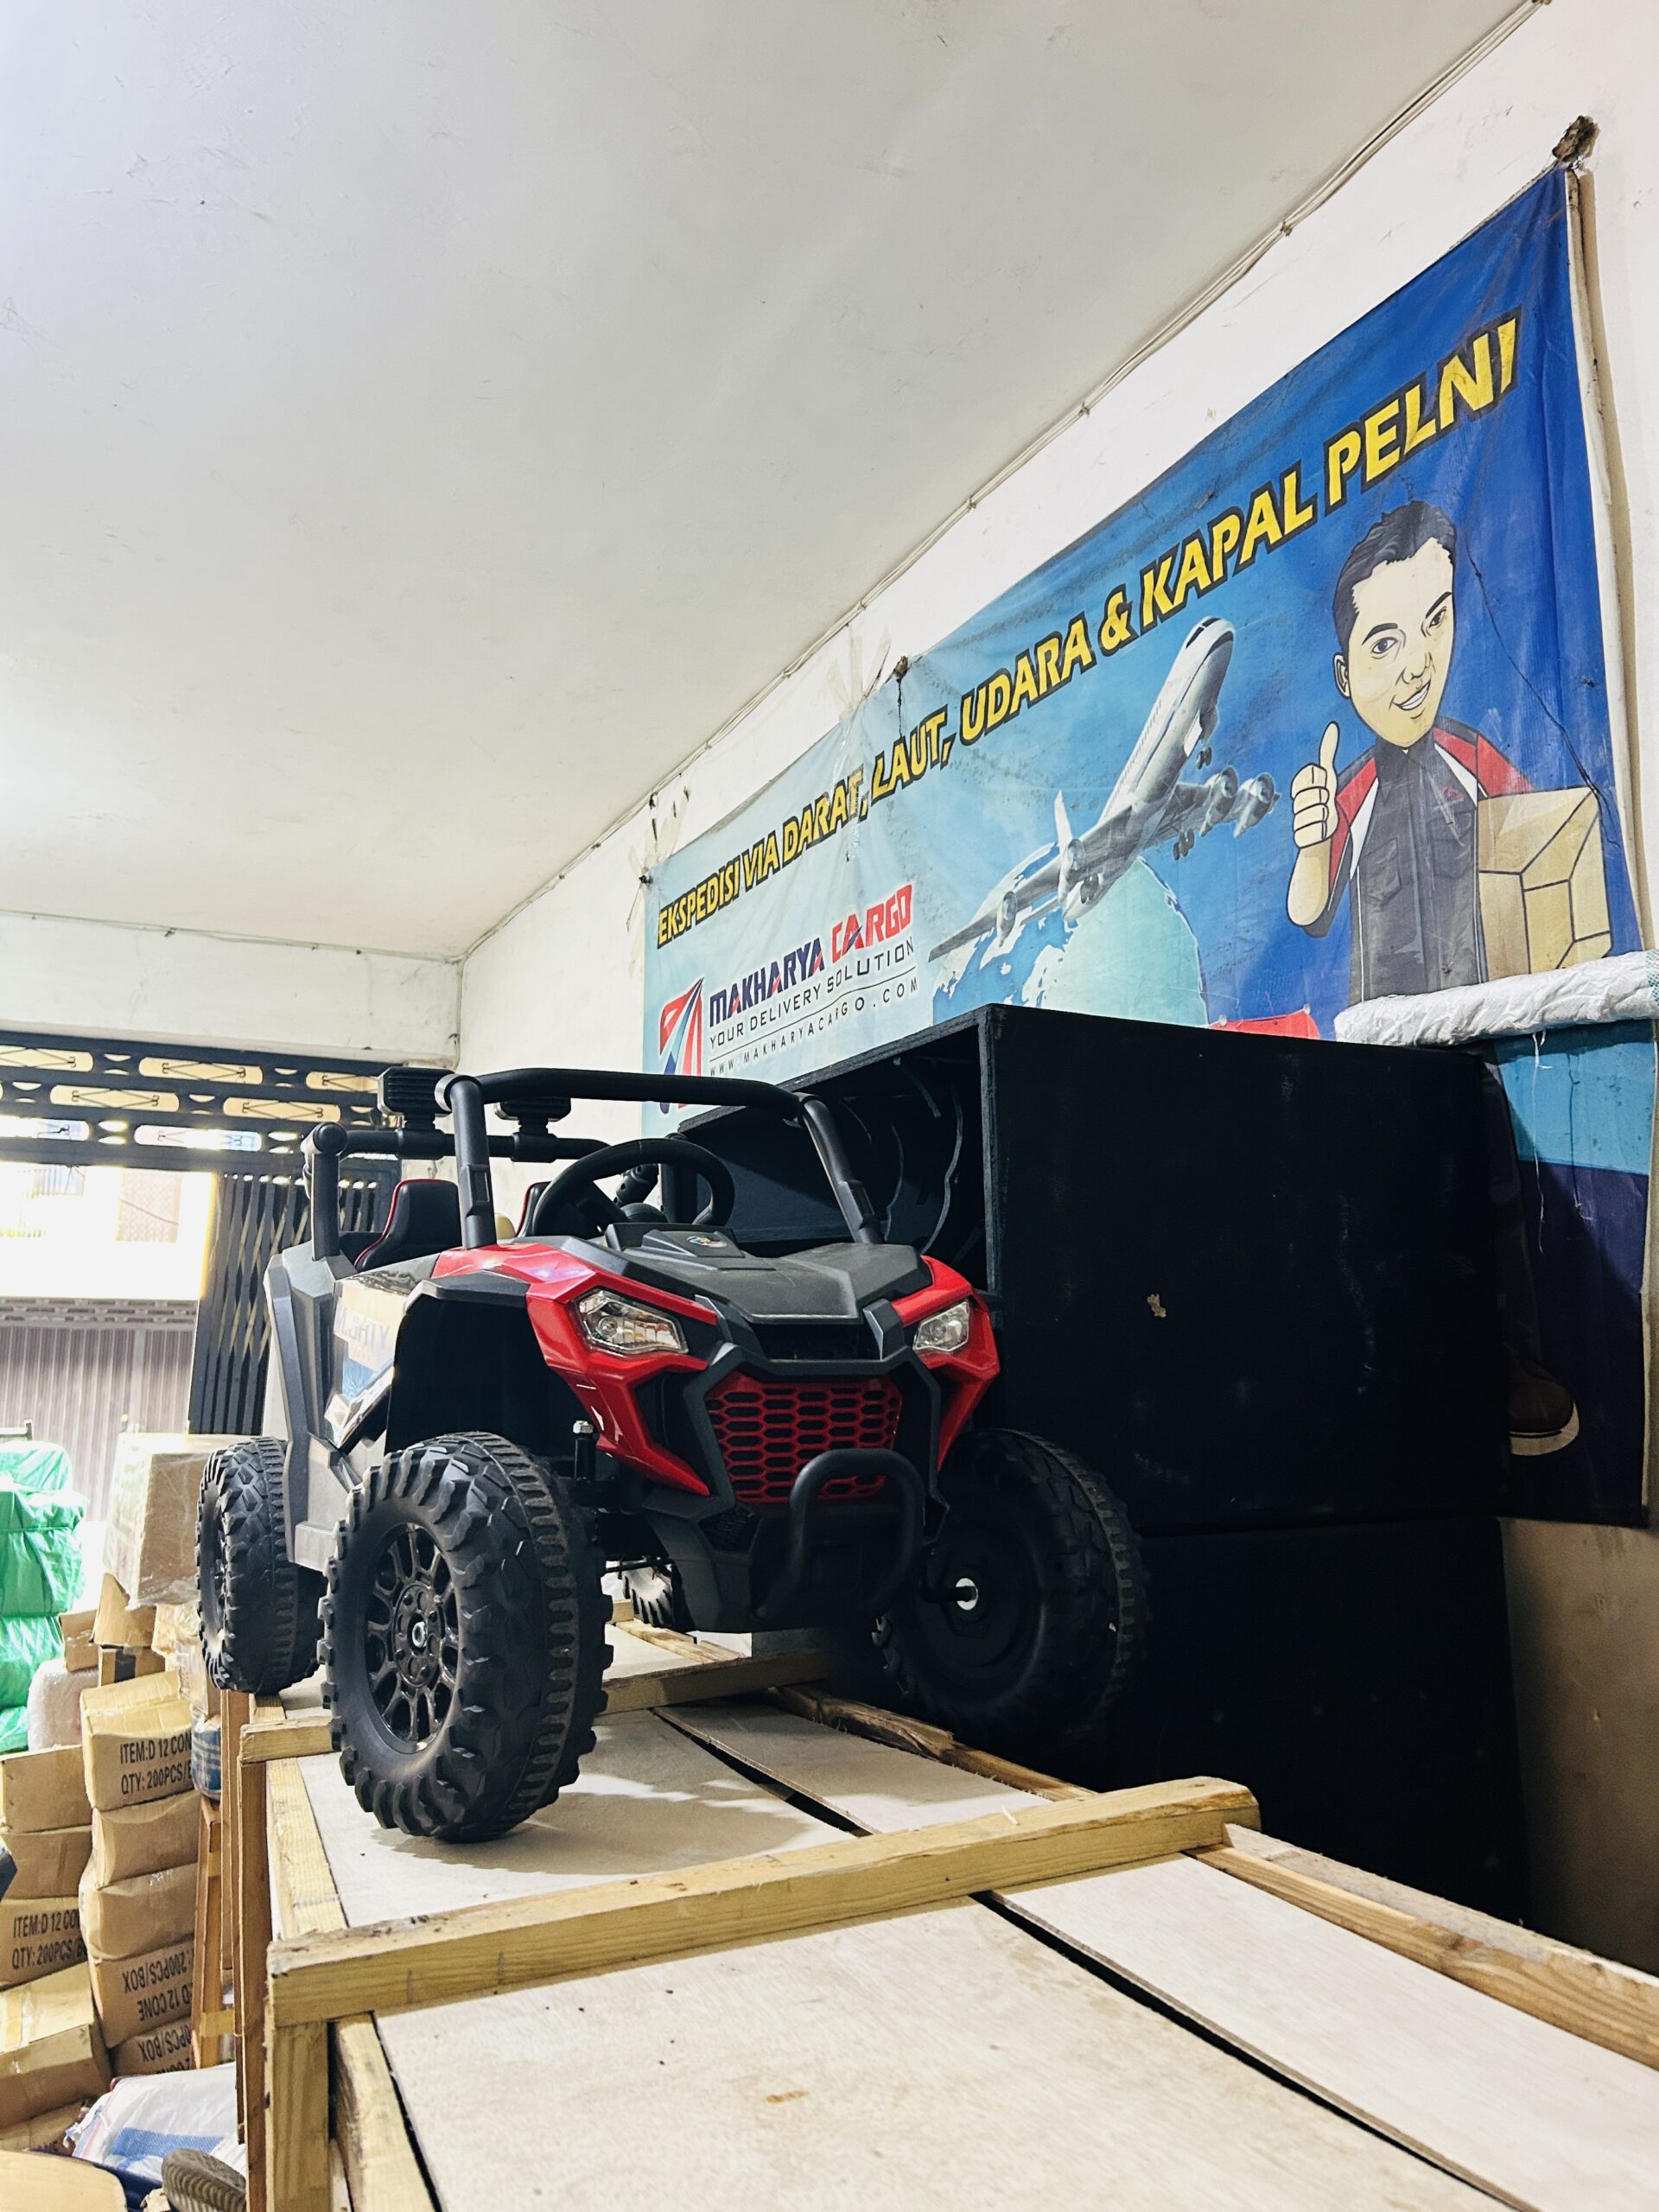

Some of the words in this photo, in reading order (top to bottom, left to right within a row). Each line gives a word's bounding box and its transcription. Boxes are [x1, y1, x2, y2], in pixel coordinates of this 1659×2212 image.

[658, 853, 741, 949] EKSPEDISI
[741, 830, 780, 892] VIA
[782, 764, 869, 868] DARAT,
[871, 704, 957, 805] LAUT,
[960, 611, 1097, 746] UDARA
[1098, 583, 1140, 657] &
[1139, 461, 1319, 632] KAPAL
[1323, 305, 1522, 516] PELNI
[709, 938, 825, 1027] MAKHARYA
[832, 884, 912, 963] CARGO
[710, 1022, 744, 1049] YOUR
[750, 983, 821, 1031] DELIVERY
[827, 936, 915, 993] SOLUTION
[158, 1738, 168, 1758] 12
[121, 1772, 145, 1795] QTY:
[51, 1911, 61, 1932] 12
[12, 1946, 35, 1969] QTY:
[122, 1951, 188, 1993] 200PCS/BOX
[137, 1993, 167, 2022] CONE
[168, 1988, 180, 2009] 12
